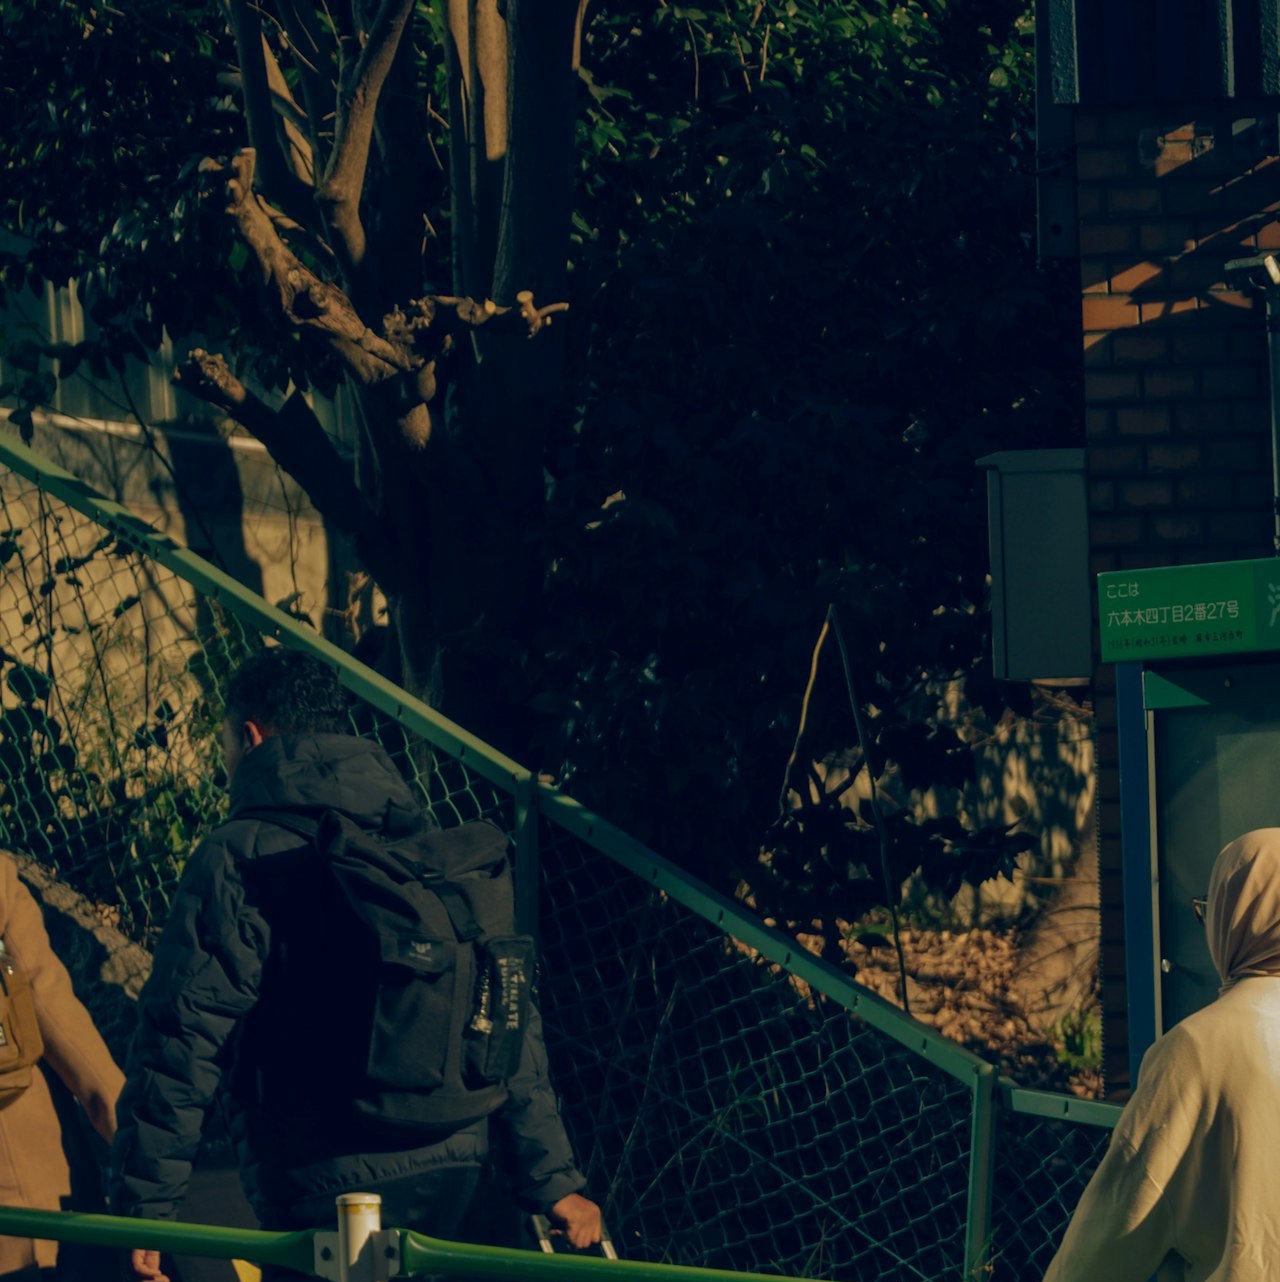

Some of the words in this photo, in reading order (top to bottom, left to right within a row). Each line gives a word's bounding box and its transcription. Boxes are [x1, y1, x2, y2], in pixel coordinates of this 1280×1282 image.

[1106, 582, 1140, 599] ここは
[1107, 600, 1240, 627] 六本木四丁目2番27号
